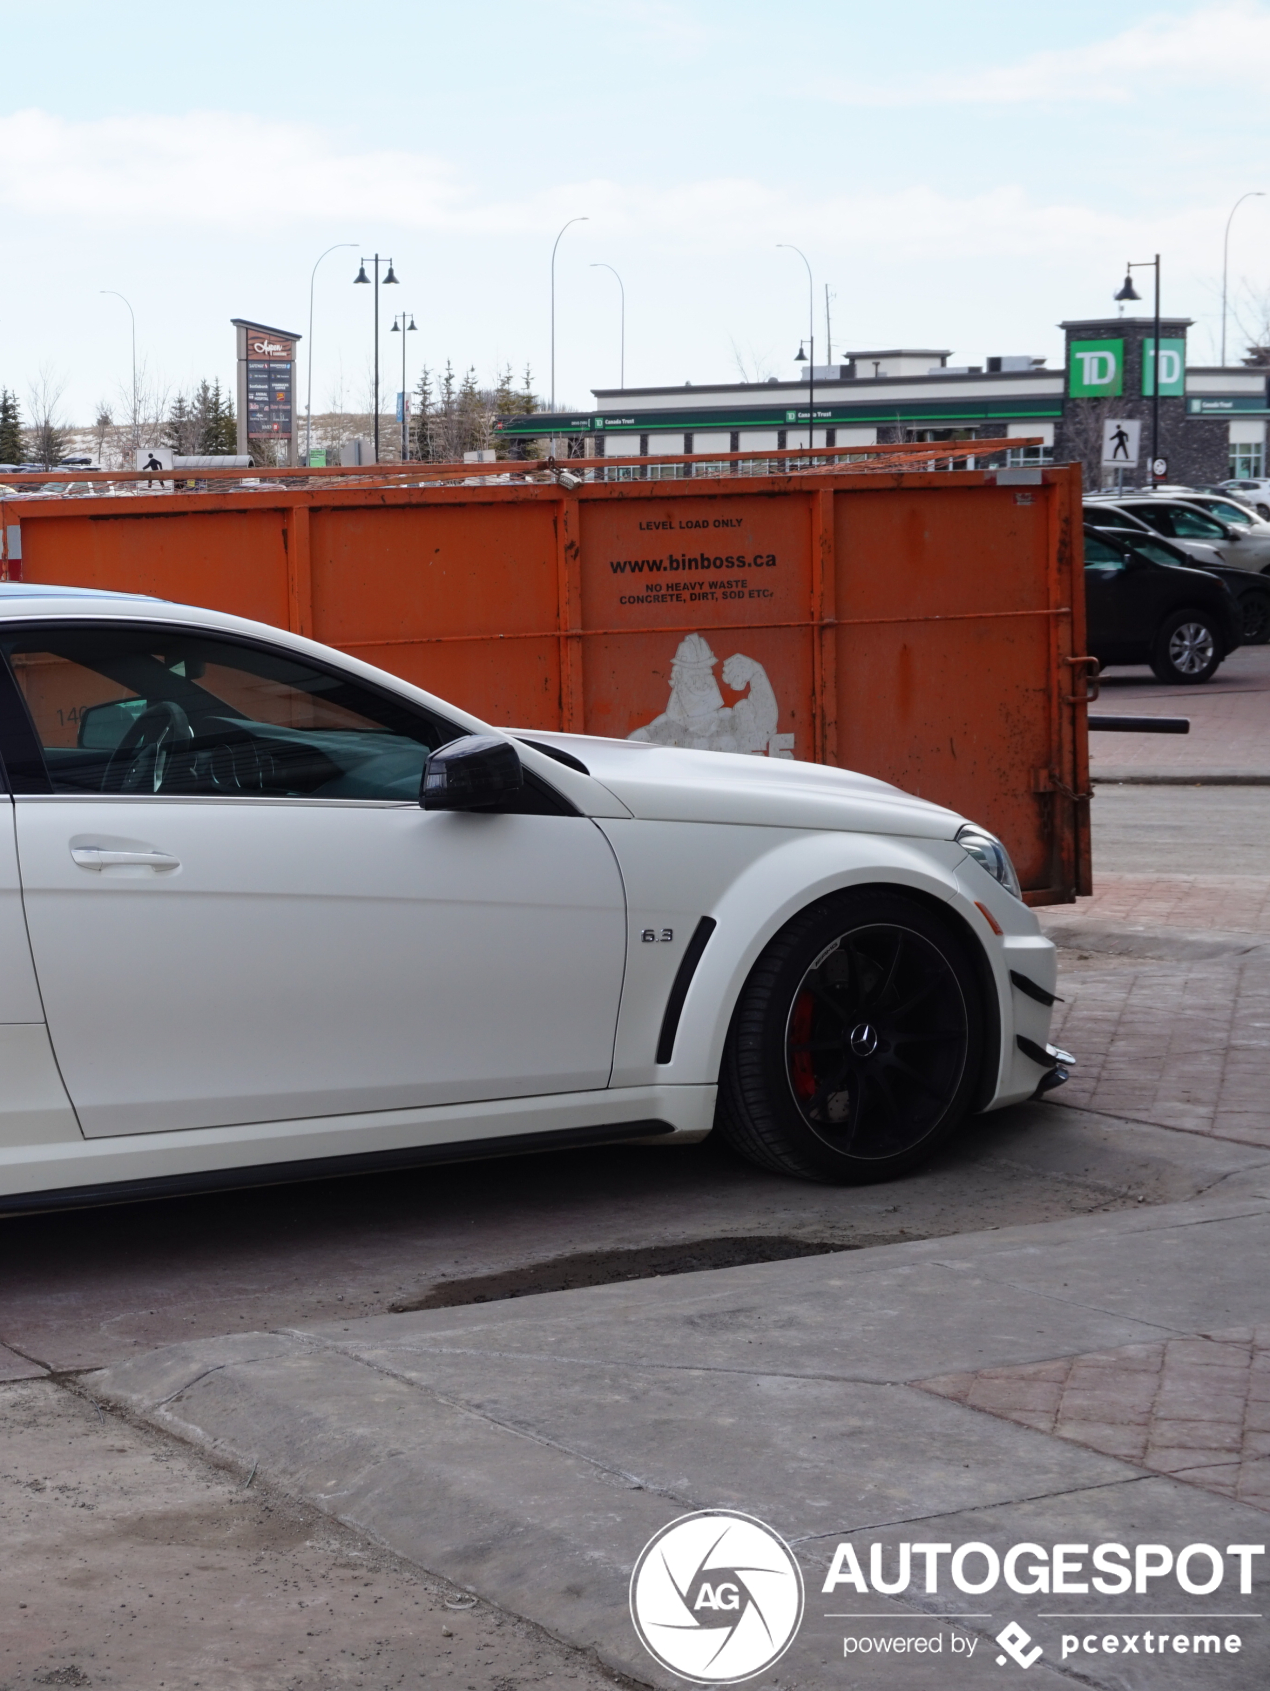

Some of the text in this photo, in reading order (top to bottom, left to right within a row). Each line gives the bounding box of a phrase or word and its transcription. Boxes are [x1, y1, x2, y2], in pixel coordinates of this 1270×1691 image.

[254, 339, 283, 356] Aspen
[1075, 351, 1116, 386] TD
[639, 518, 743, 531] LEVEL LOAD ONLY
[610, 553, 777, 574] www.binboss.ca
[645, 579, 748, 593] NO HEAVY WASTE
[619, 593, 687, 605] CONCRETE,
[690, 591, 719, 603] DIRT,
[722, 590, 745, 600] SOD
[640, 928, 673, 943] 6.3
